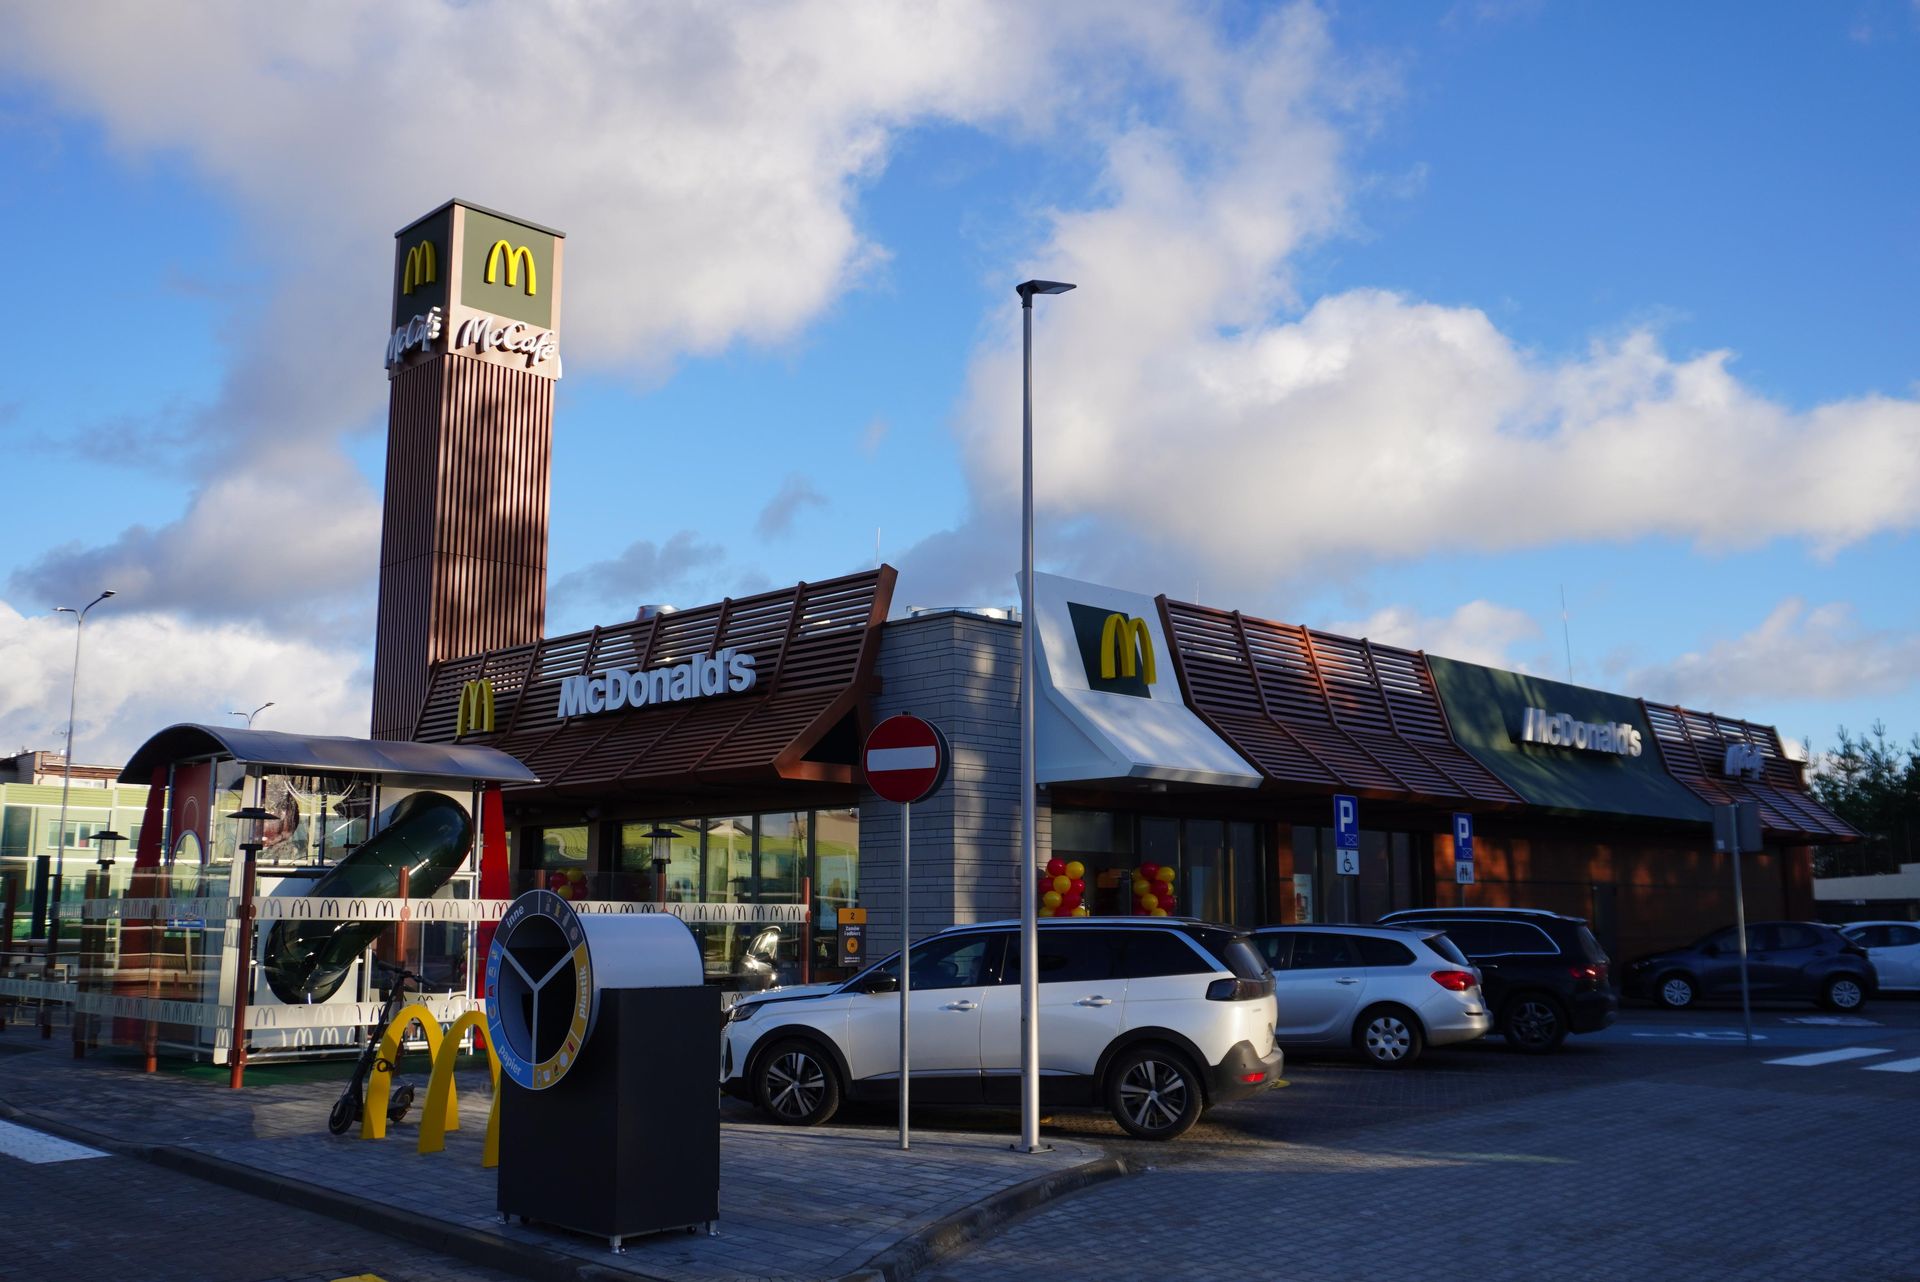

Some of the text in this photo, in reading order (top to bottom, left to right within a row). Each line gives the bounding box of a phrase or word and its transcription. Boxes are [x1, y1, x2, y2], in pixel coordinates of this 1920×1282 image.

[457, 316, 558, 368] McCafé
[557, 648, 758, 719] McDonald's
[1521, 706, 1643, 758] McDonald's
[1339, 800, 1354, 833] P
[1457, 817, 1470, 847] P
[505, 905, 525, 929] inne
[850, 911, 856, 921] 2
[498, 1045, 522, 1077] papier
